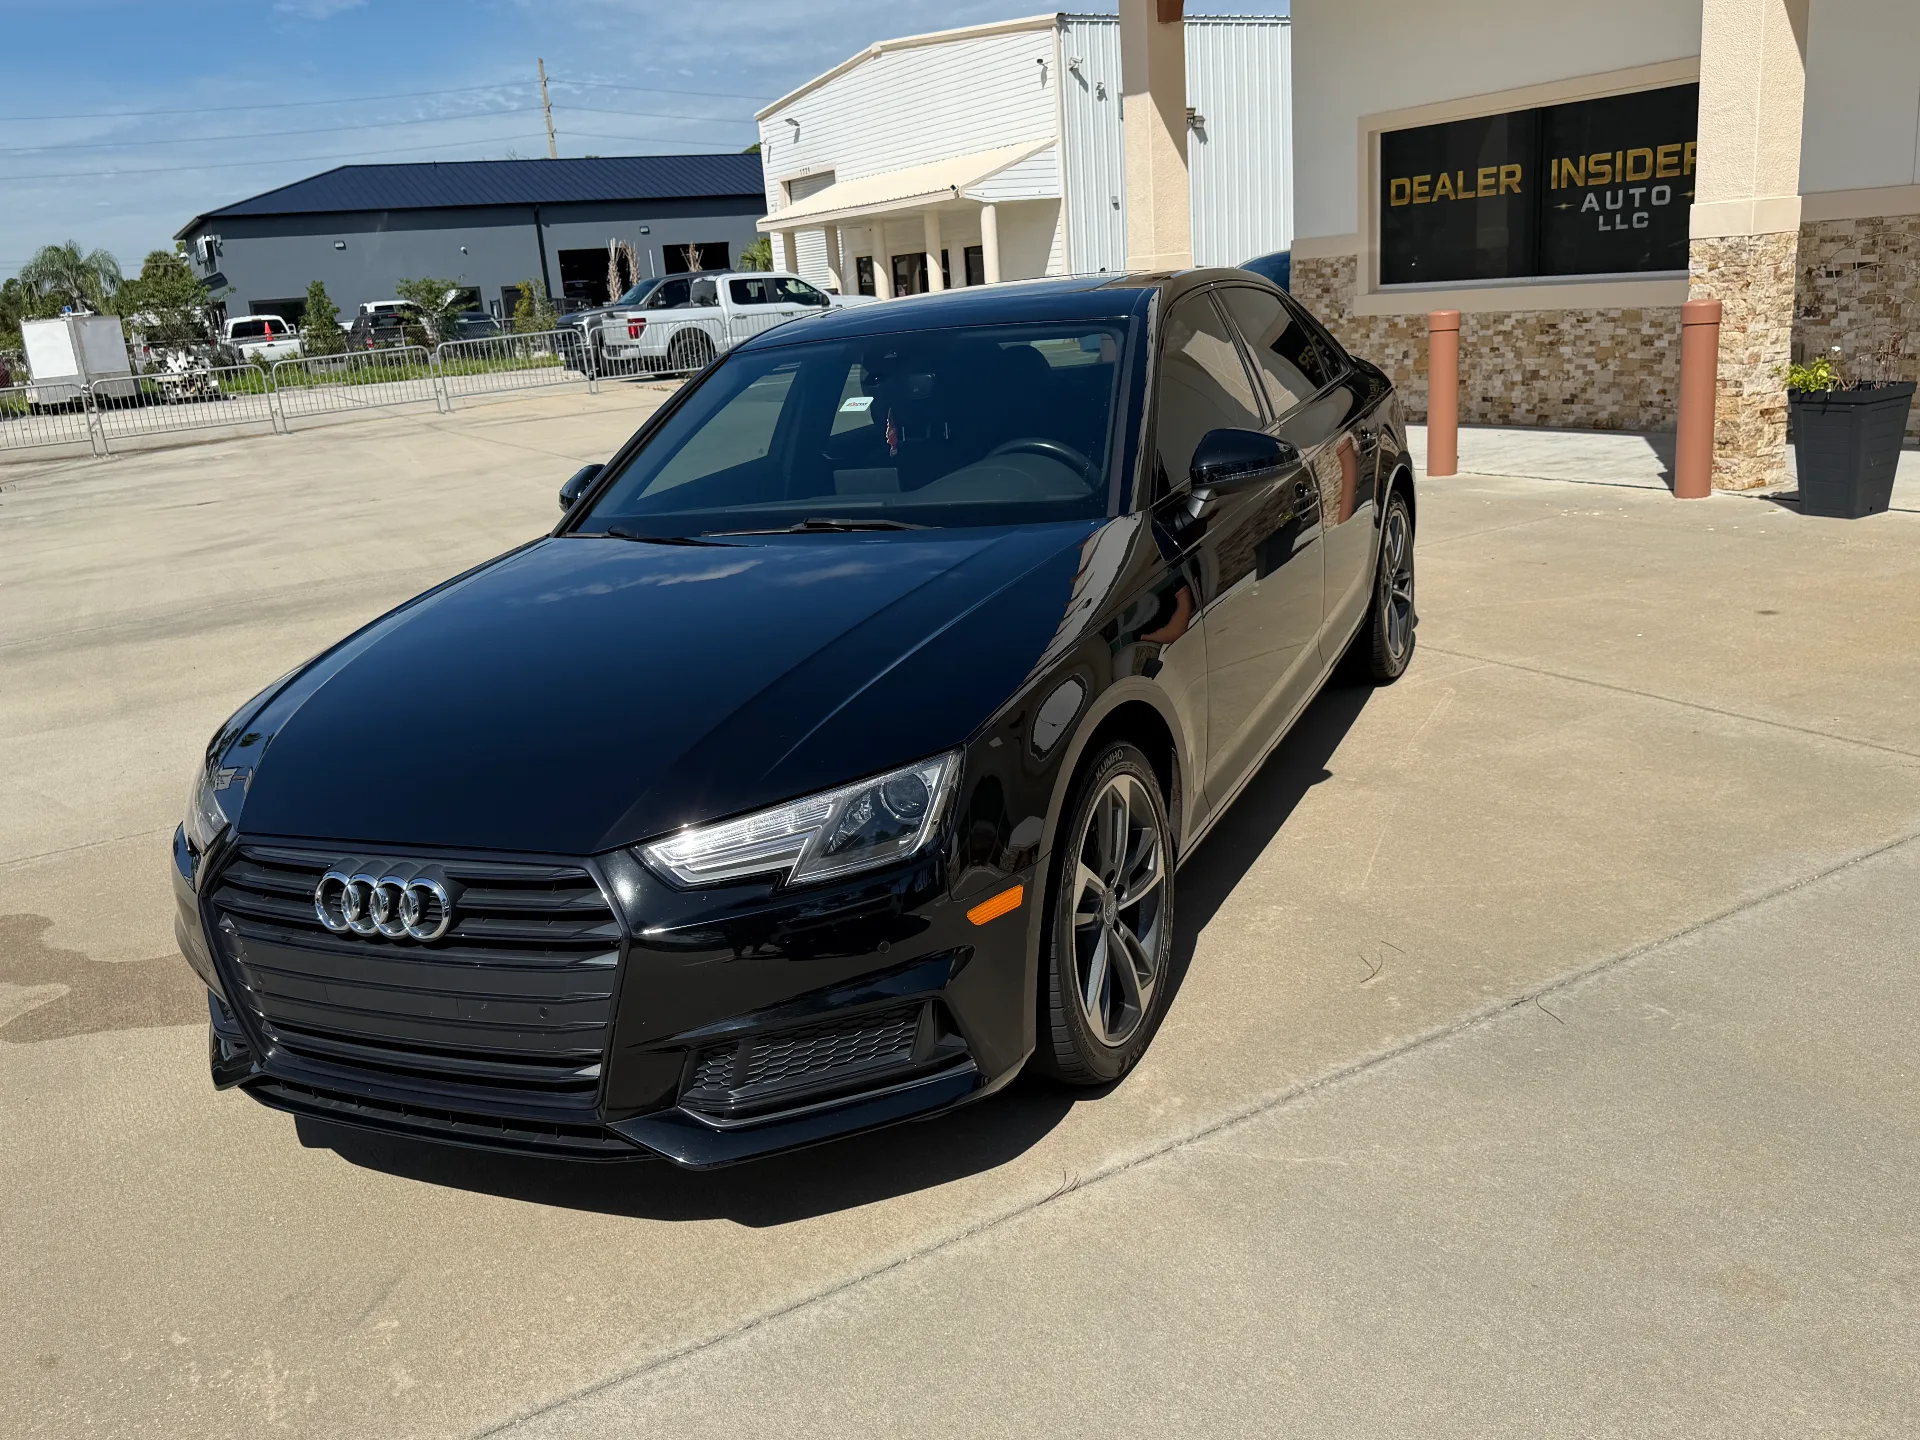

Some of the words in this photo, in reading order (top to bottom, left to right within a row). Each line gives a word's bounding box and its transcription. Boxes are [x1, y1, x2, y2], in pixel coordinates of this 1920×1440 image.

[1390, 163, 1522, 206] DEALER
[1580, 185, 1671, 212] AUTO
[1598, 211, 1649, 231] LLC
[1095, 748, 1124, 782] KUMHO
